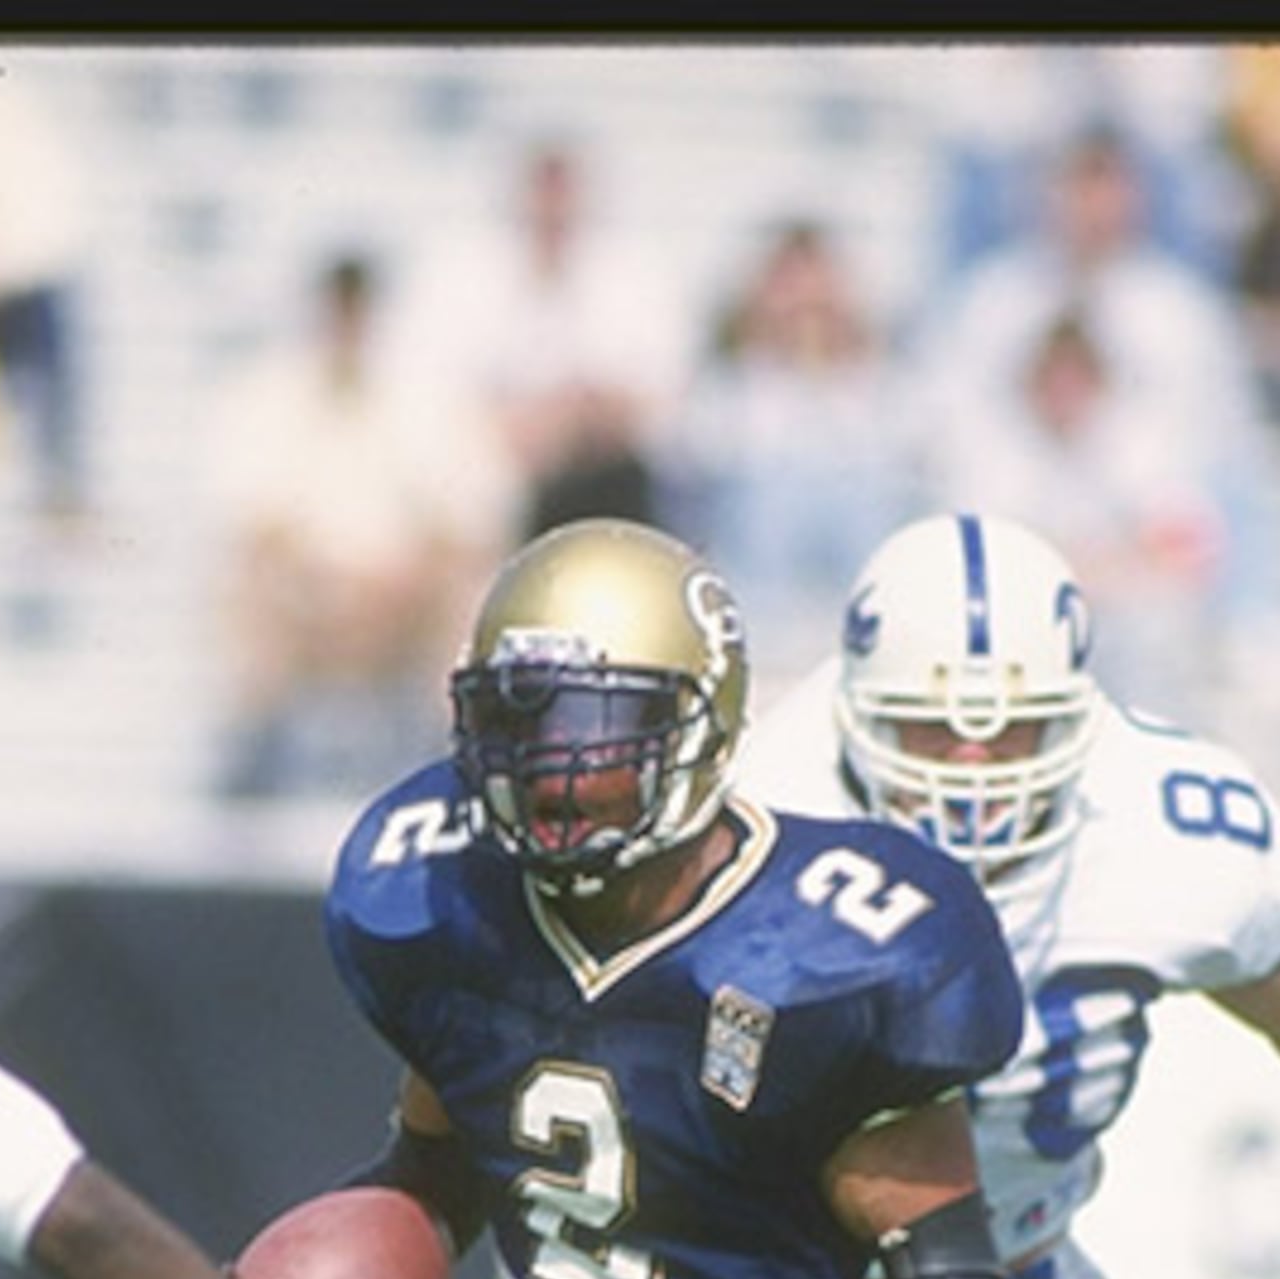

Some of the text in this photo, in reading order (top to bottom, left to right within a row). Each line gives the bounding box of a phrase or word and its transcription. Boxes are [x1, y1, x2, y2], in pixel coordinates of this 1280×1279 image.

[370, 797, 472, 866] 2
[796, 847, 936, 945] 2
[1022, 962, 1163, 1163] 0
